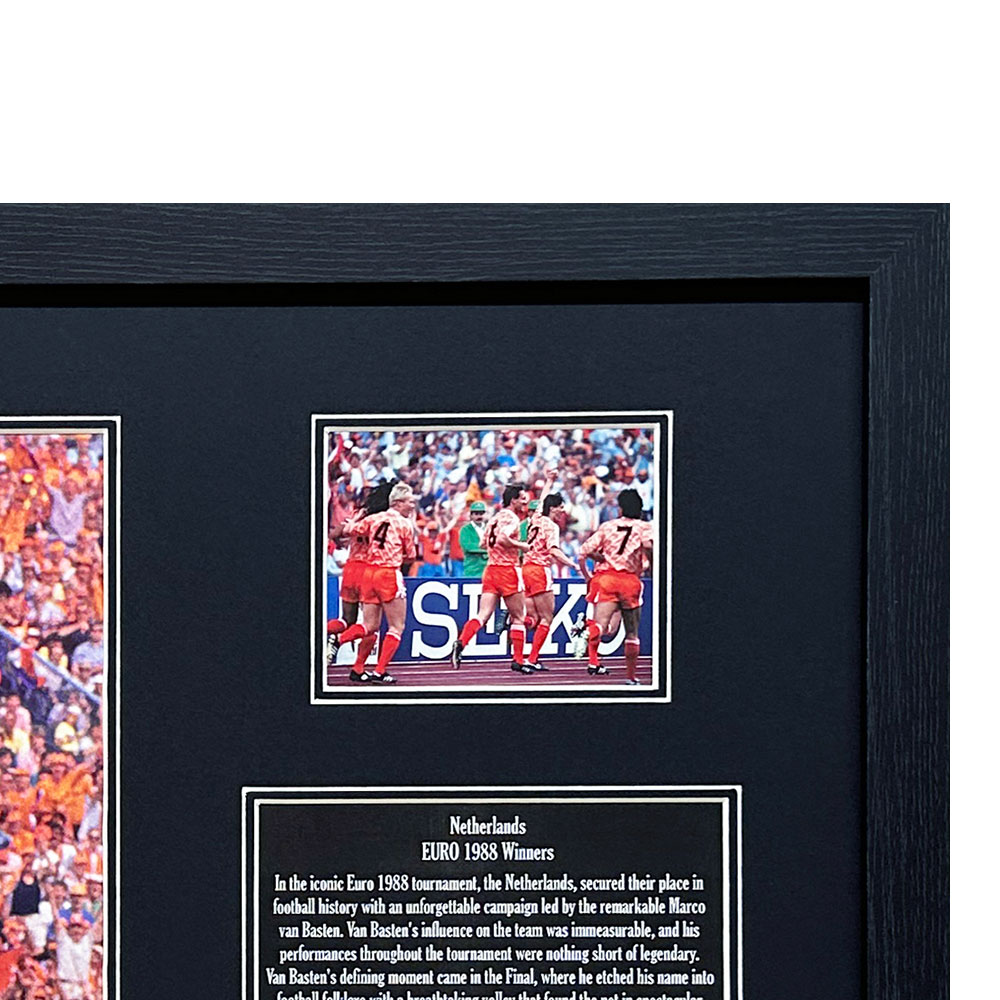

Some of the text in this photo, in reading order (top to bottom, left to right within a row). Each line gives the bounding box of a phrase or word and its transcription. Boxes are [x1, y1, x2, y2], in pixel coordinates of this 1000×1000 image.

[374, 522, 390, 550] 4
[616, 526, 632, 555] 7
[411, 581, 626, 659] SEK
[449, 816, 527, 835] Netherlands
[421, 842, 555, 860] EURO 1988 Winners
[274, 873, 704, 893] In the iconic Euro 1988 tournament, the Netherlands, secured their place in
[272, 897, 707, 917] football history with an unforgettable campaign led by the remarkable Marco
[278, 921, 701, 940] van Basten. Van Basten's influence on the team was immeasurable, and his
[279, 944, 701, 964] performances throughout the tournament were nothing short of legendary.
[265, 967, 715, 987] Van Basten's defining moment came in the Final, where he etched his name into
